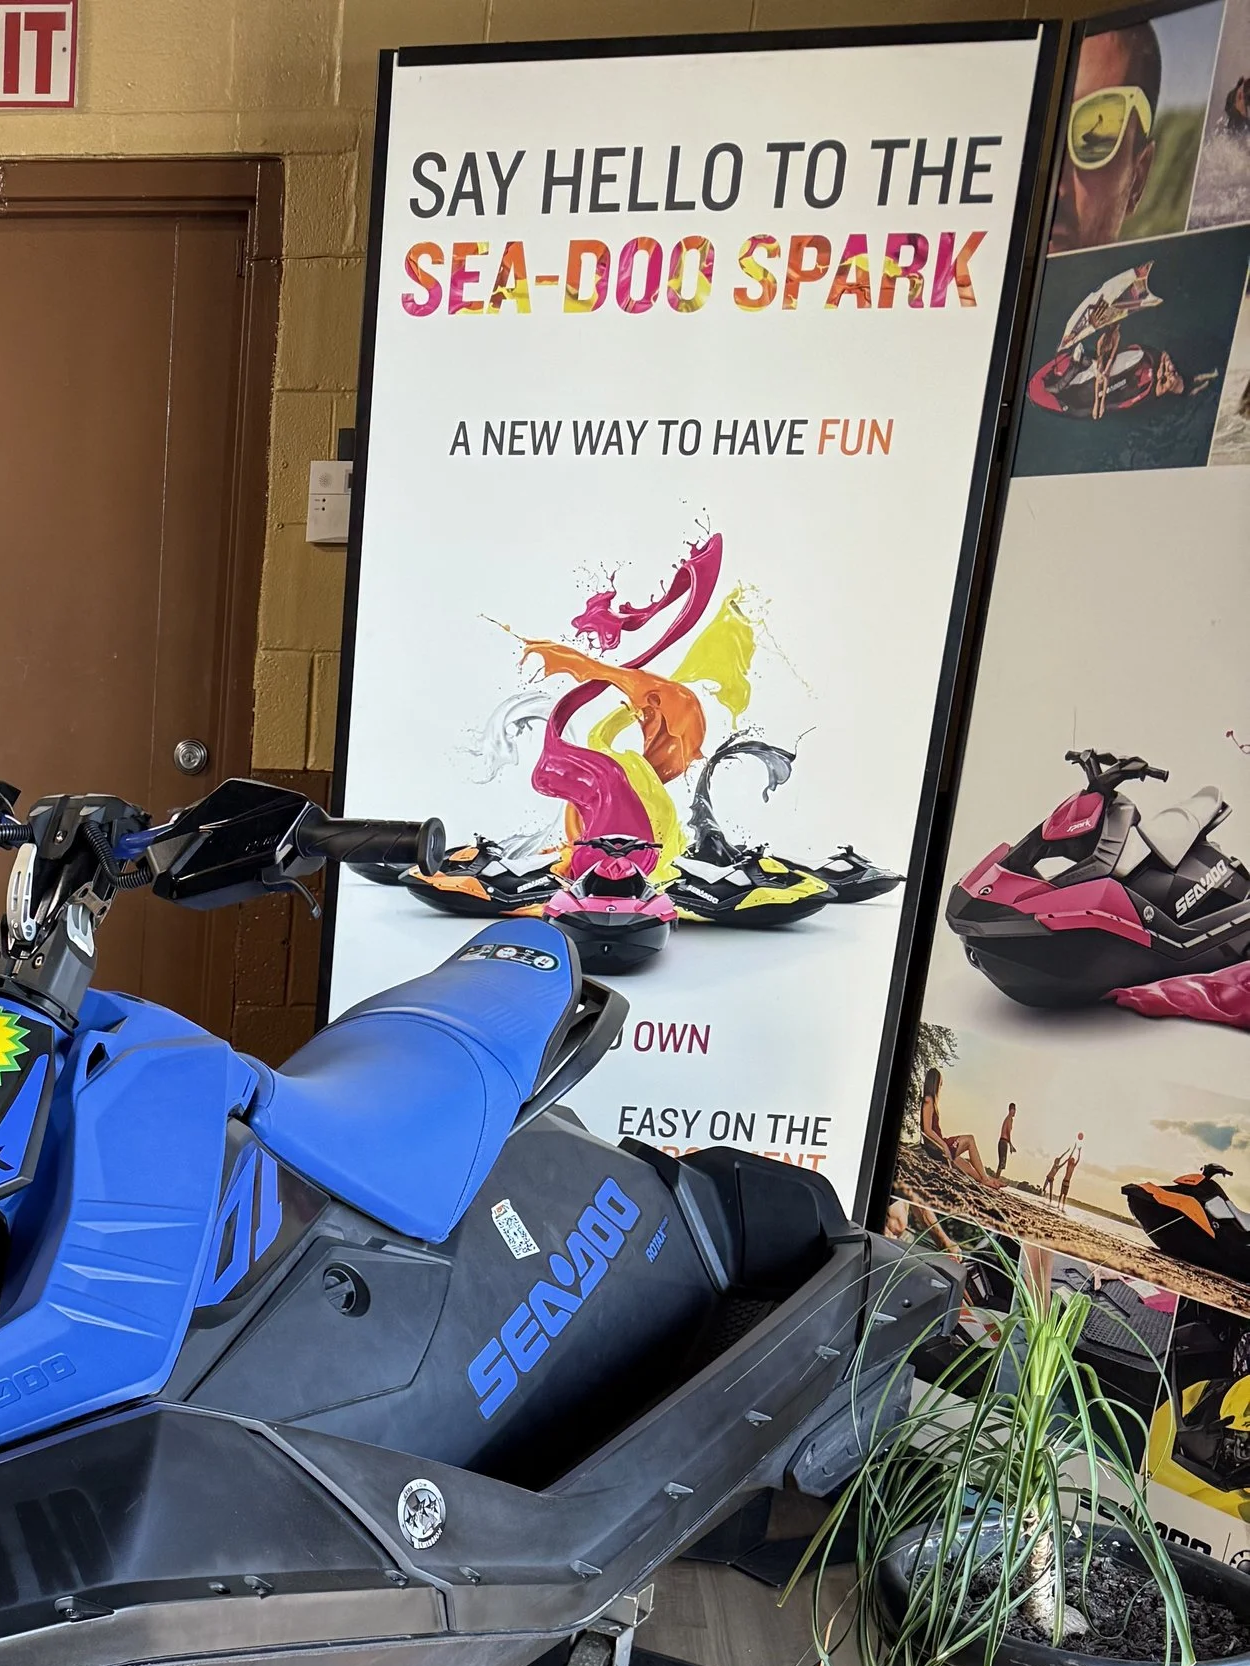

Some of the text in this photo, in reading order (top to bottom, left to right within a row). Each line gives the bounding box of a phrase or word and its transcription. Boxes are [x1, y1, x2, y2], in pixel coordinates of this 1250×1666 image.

[409, 136, 1003, 218] SAY HELLO TO THE
[401, 230, 989, 318] SEA-DOO SPARK
[450, 418, 894, 456] A NEW WAY TO HAVE FUN
[633, 1020, 711, 1055] OWN
[618, 1105, 833, 1147] EASY ON THE
